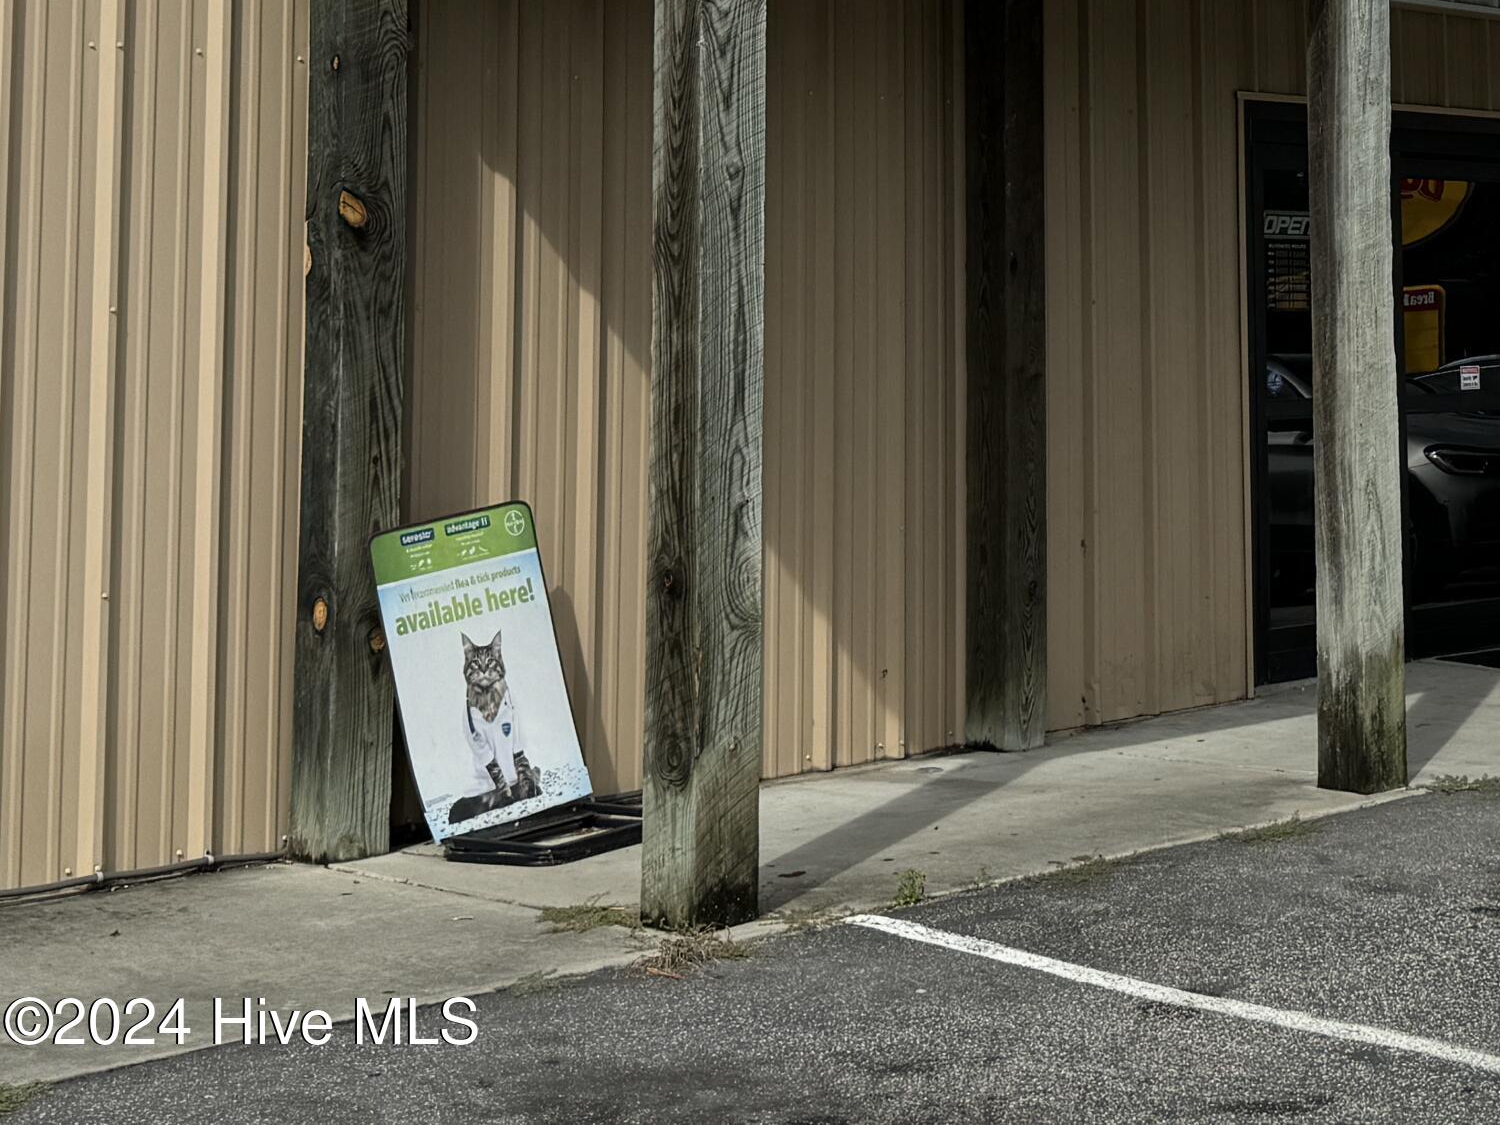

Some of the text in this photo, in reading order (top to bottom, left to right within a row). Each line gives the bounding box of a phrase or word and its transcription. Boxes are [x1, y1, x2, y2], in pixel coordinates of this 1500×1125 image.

[476, 571, 491, 585] tick
[491, 566, 521, 583] products
[395, 577, 535, 636] available here!
